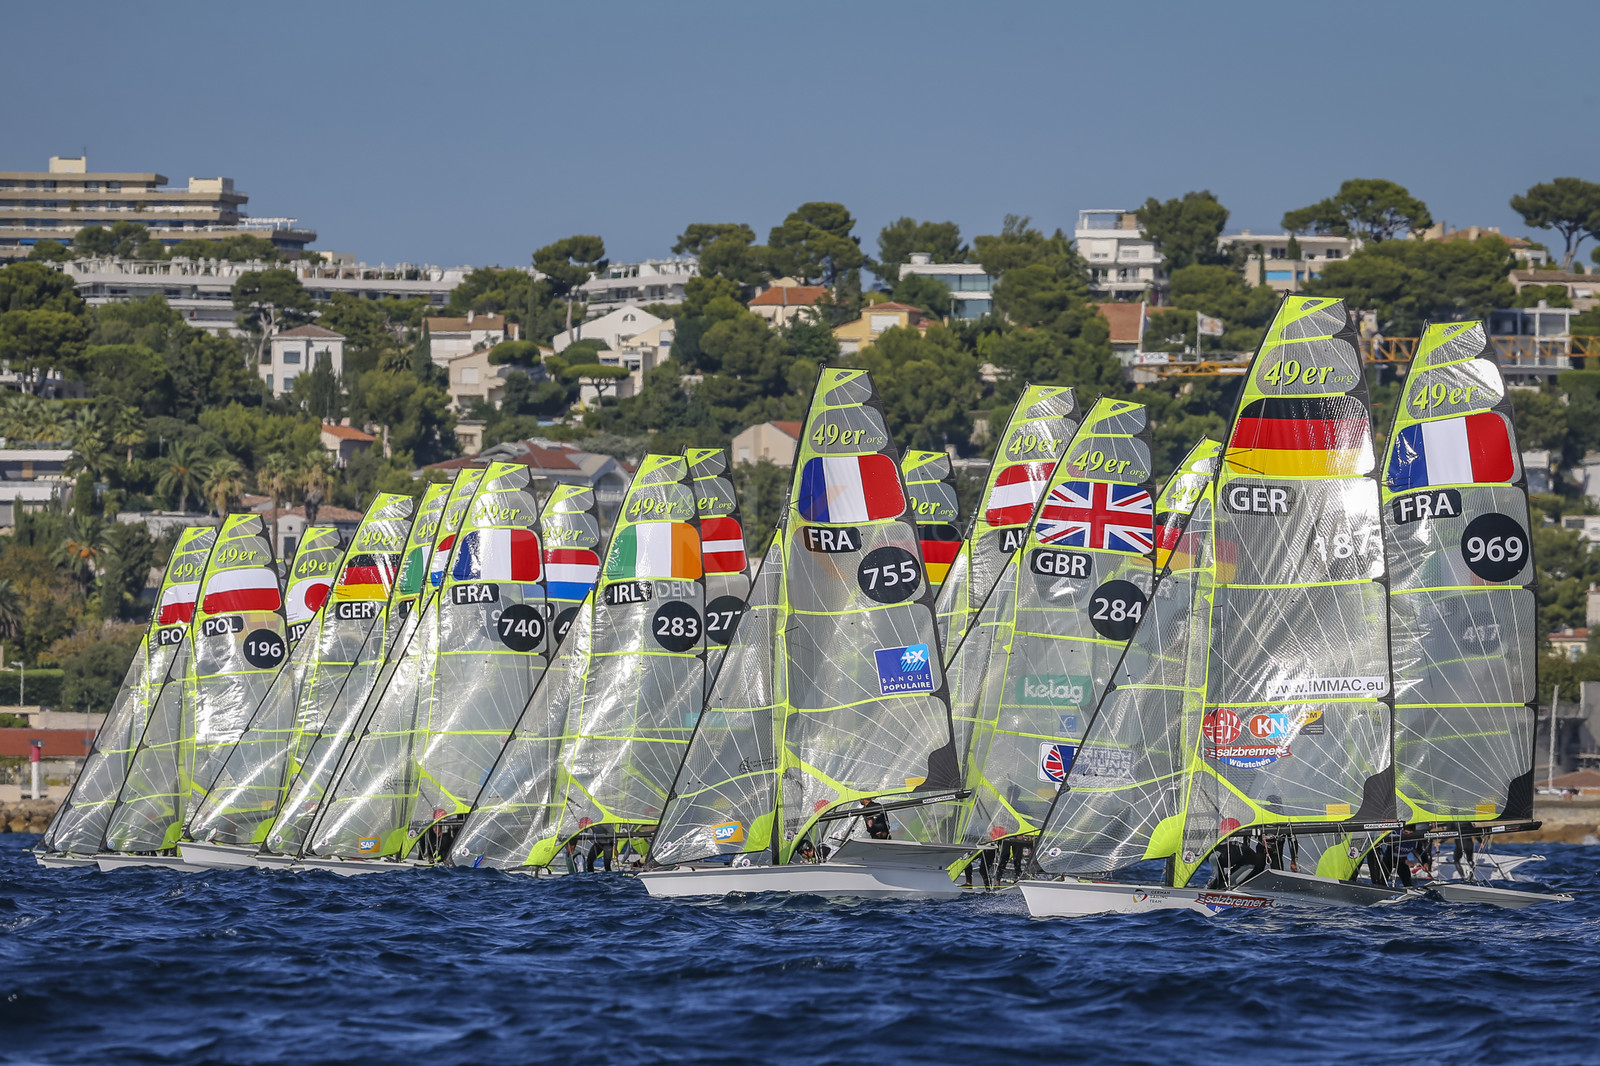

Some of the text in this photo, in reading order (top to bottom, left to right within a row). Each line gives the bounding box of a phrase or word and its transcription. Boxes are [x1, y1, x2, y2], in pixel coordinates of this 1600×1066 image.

[1229, 486, 1288, 513] GER
[1399, 492, 1454, 522] FRA
[808, 529, 855, 550] FRA
[1466, 536, 1523, 562] 969
[173, 562, 203, 578] 49e
[1036, 552, 1087, 577] GBR
[863, 560, 916, 590] 755
[457, 584, 494, 603] FRA
[613, 585, 642, 604] IRL
[657, 582, 696, 598] DEN
[340, 602, 372, 619] GER
[1093, 598, 1142, 624] 284
[205, 618, 238, 636] POL
[502, 618, 541, 638] 740
[657, 616, 698, 638] 283
[707, 611, 742, 631] 27
[160, 628, 185, 645] PO
[290, 623, 309, 642] JP
[248, 641, 282, 658] 196
[882, 673, 930, 684] BANQUE
[883, 681, 931, 692] POPULAIRE
[1023, 677, 1083, 703] kelag
[1256, 717, 1286, 735] KN
[1229, 758, 1271, 768] Würstchen
[715, 827, 734, 838] SAP
[361, 841, 375, 849] SAP
[1206, 894, 1263, 908] salzbrenner
